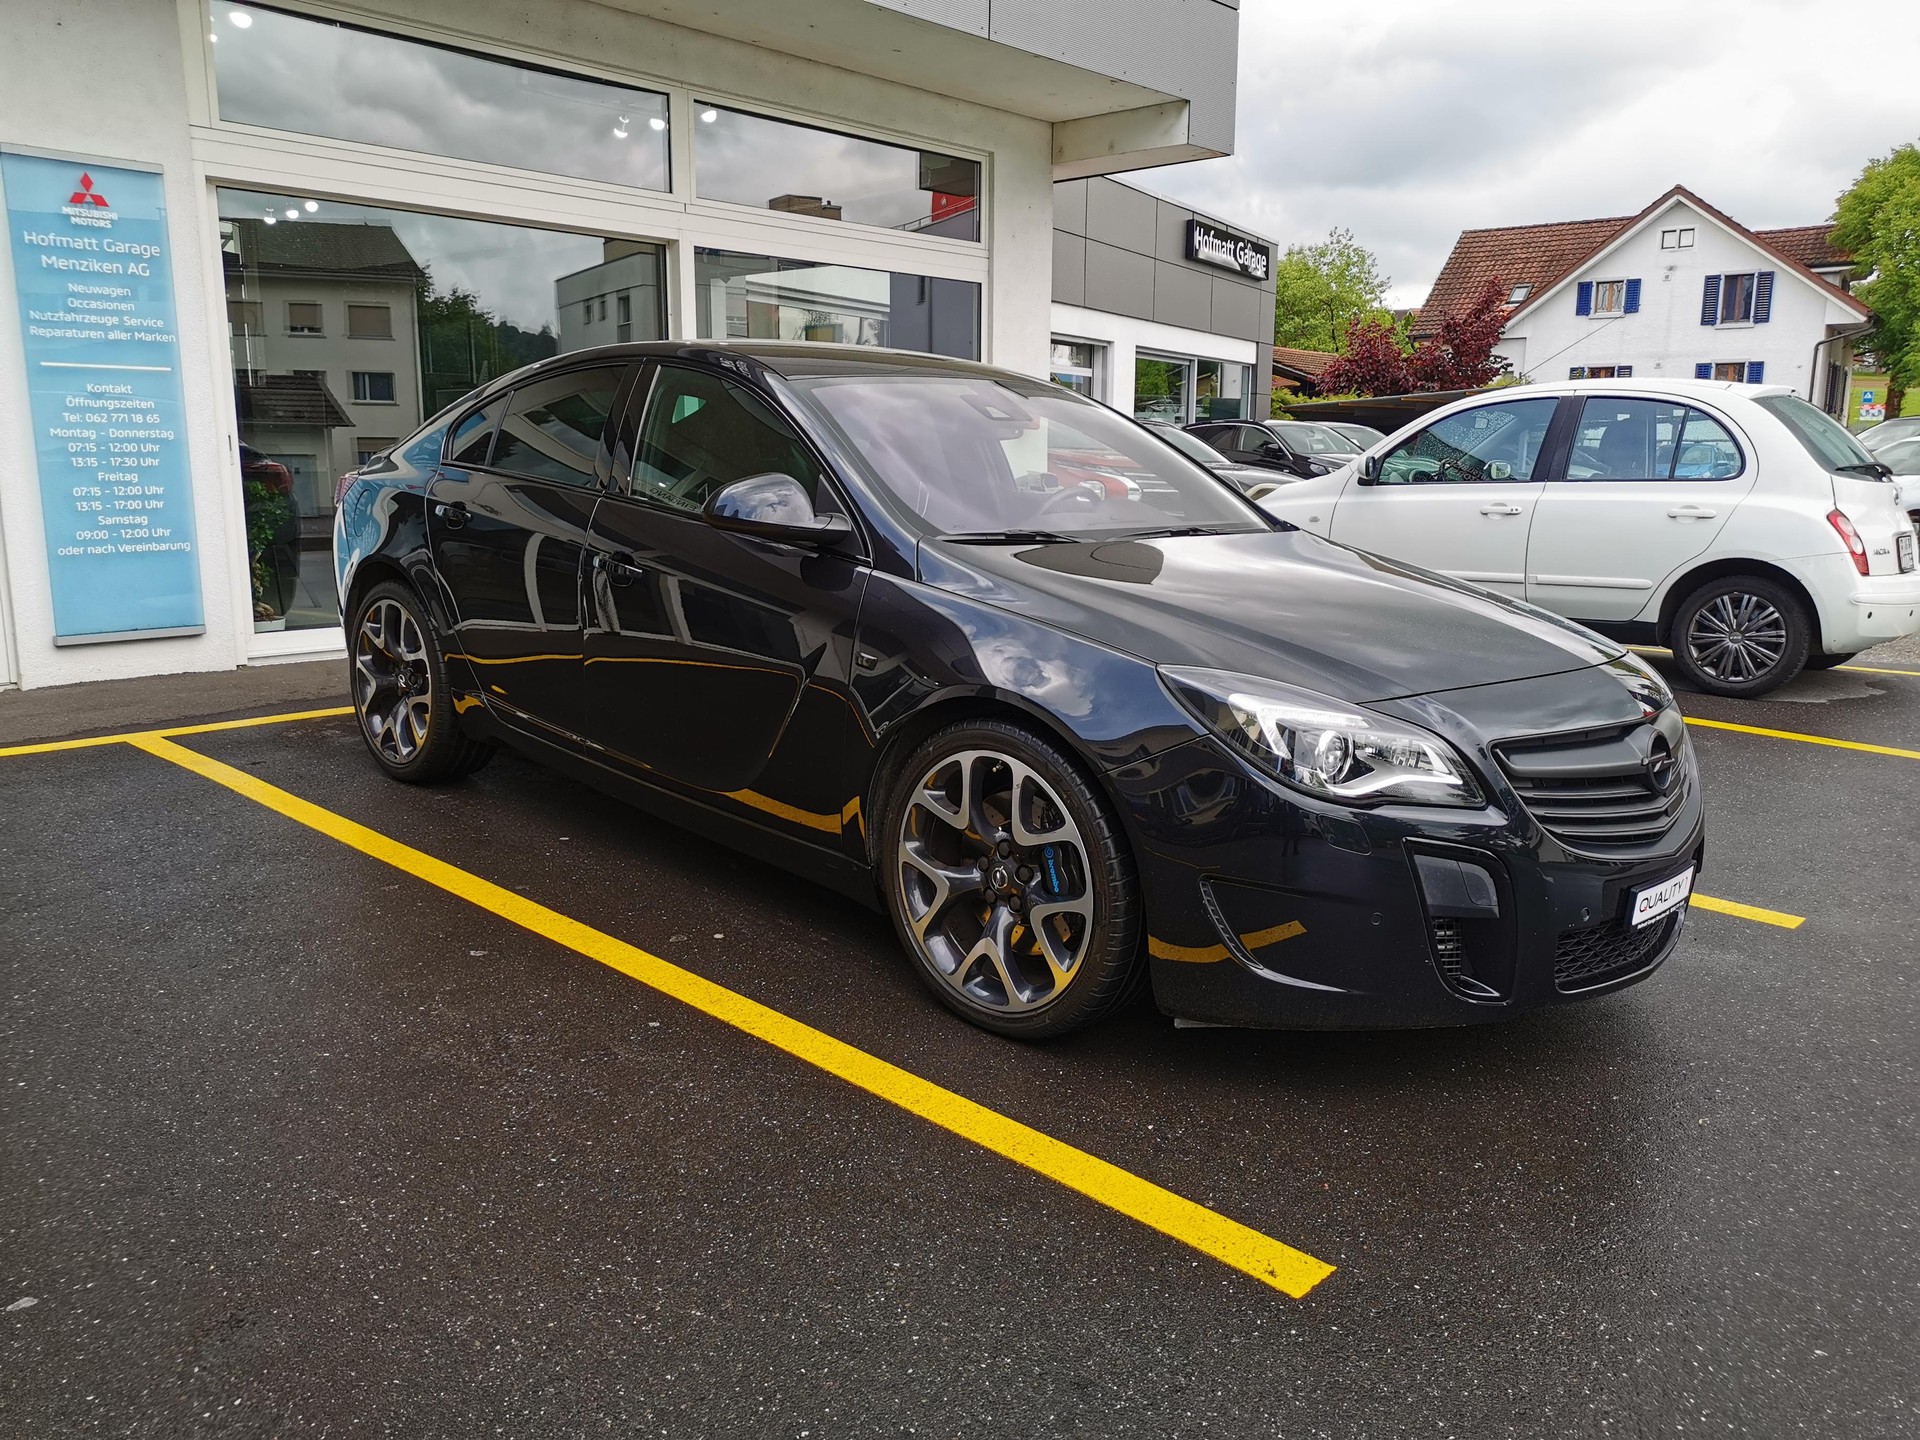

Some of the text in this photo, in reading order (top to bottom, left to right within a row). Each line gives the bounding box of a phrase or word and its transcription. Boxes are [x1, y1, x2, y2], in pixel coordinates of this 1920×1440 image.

[62, 206, 118, 220] MITSUBISHI
[71, 217, 112, 229] MOTORS
[23, 230, 161, 259] Hofmatt Garage
[1195, 226, 1266, 275] Hofmatt Garage
[41, 255, 150, 277] Menziken AG
[68, 283, 131, 298] Neuwagen
[67, 298, 135, 311] Occasionen
[29, 310, 164, 328] Nutzfahrzeuge Service
[29, 326, 176, 343] Reparaturen aller Marken
[86, 383, 132, 394] Kontakt
[66, 396, 155, 411] Öffnungszeiten
[63, 413, 160, 423] Tel: 062 771 18 65
[50, 428, 96, 441] Montag
[109, 428, 174, 440] Donnerstag
[68, 443, 97, 453] 07:15
[109, 443, 138, 452] 12:00
[141, 443, 160, 452] Uhr
[71, 457, 98, 467] 13:15
[109, 457, 138, 467] 17:30
[141, 457, 160, 466] Uhr
[98, 472, 139, 483] Freitag
[73, 487, 101, 497] 07:15
[113, 486, 142, 495] 12:00
[145, 486, 164, 495] Uhr
[76, 502, 102, 511] 13:15
[114, 501, 142, 510] 17:00
[145, 500, 164, 509] Uhr
[98, 515, 148, 526] Samstag
[76, 530, 108, 540] 09:00
[120, 529, 149, 539] 12:00
[152, 528, 172, 537] Uhr
[58, 541, 191, 556] oder nach Vereinbarung
[1048, 859, 1059, 892] brembo
[1639, 878, 1684, 912] QUALITY
